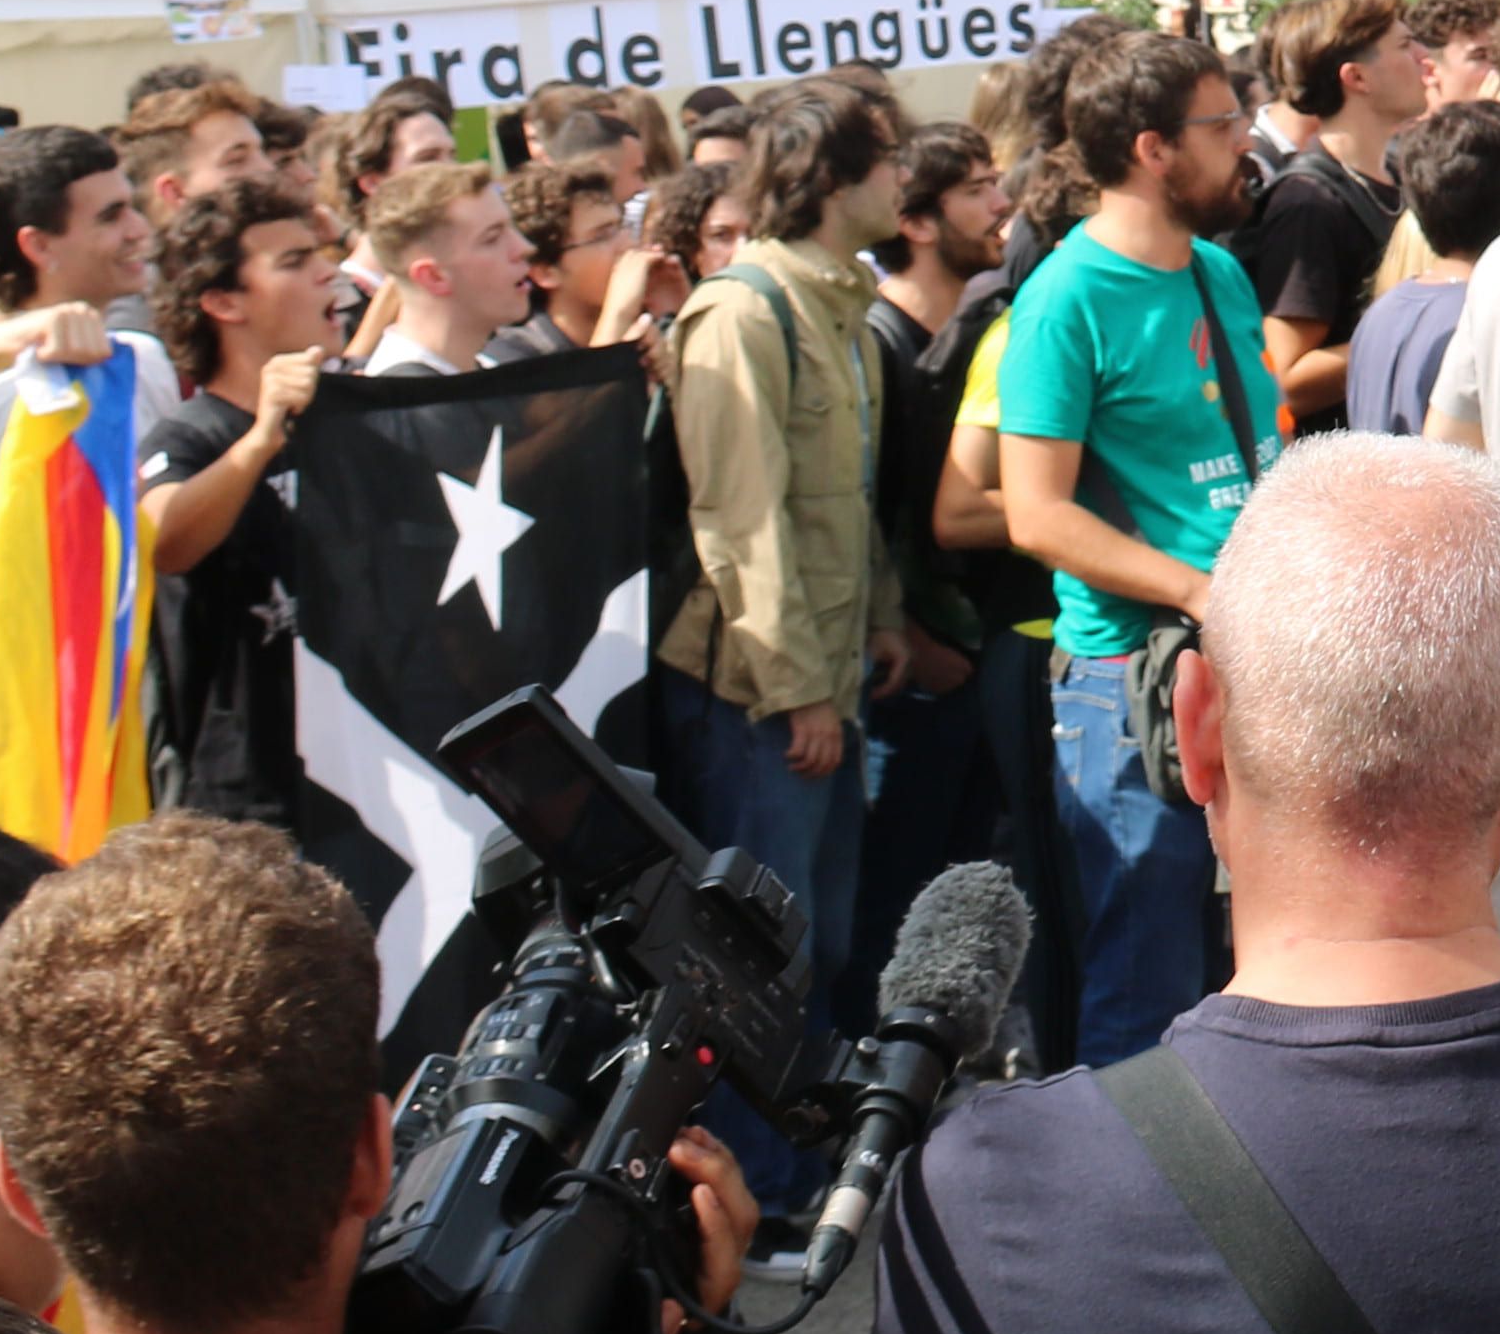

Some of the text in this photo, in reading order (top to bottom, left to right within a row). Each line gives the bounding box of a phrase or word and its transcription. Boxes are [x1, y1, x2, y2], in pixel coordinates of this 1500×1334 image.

[345, 23, 524, 98] Fira
[566, 5, 664, 88] de
[1189, 454, 1240, 484] MAKE
[479, 1128, 520, 1185] Panasonic
